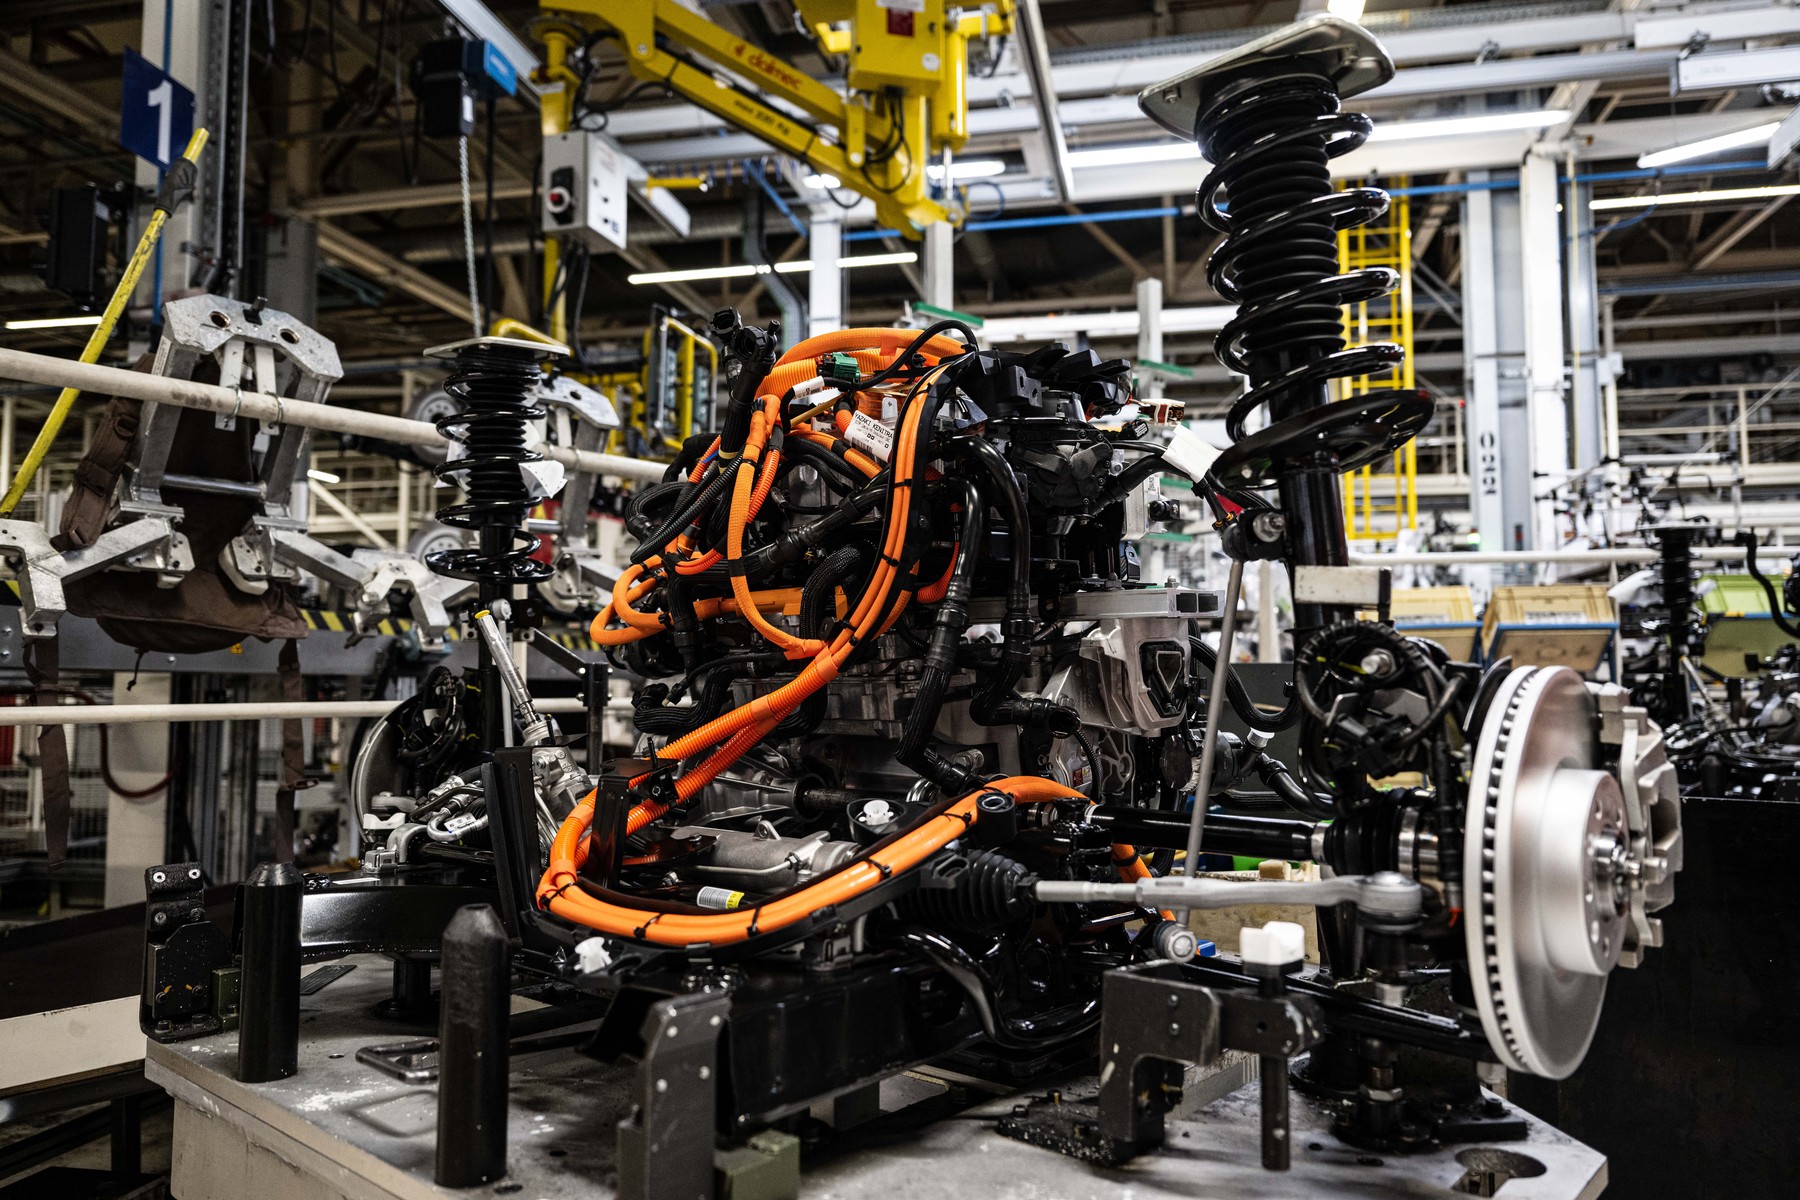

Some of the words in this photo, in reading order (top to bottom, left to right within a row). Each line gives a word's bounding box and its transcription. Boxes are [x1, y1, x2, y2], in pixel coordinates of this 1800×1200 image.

[147, 79, 173, 165] 1
[854, 412, 872, 427] YAZAKI
[872, 423, 893, 439] KENITRA
